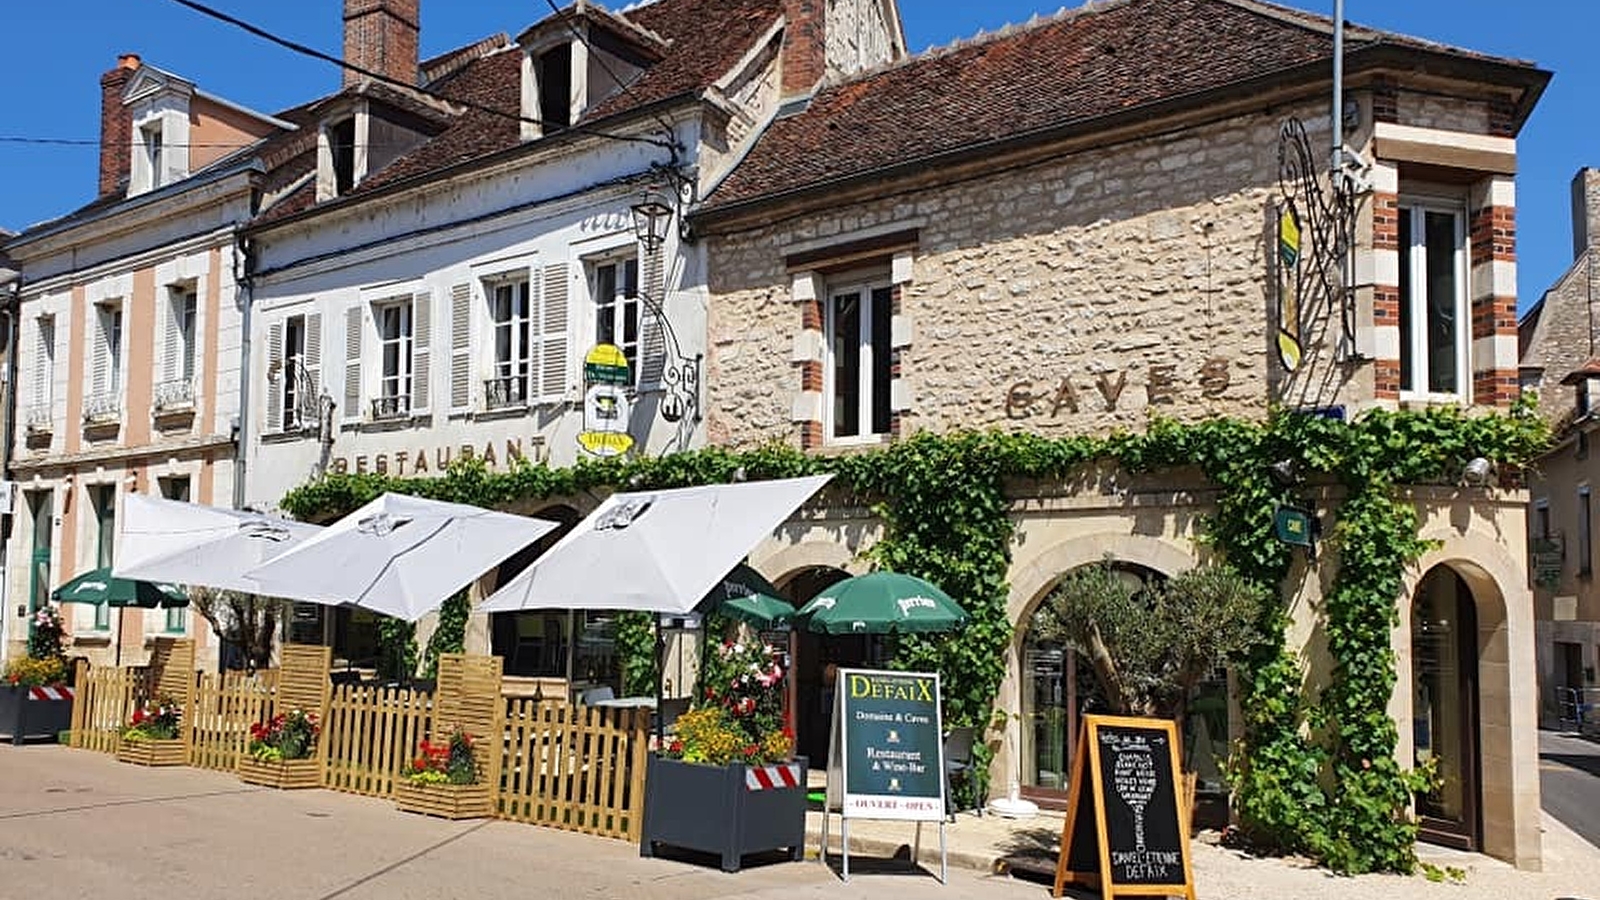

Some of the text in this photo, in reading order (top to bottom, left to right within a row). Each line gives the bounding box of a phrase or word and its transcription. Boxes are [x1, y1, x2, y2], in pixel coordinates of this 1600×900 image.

[1005, 356, 1231, 420] CAVES
[333, 436, 546, 475] RESTAURANT
[866, 746, 921, 760] Restaurant
[855, 799, 933, 811] OUVERT OPEN
